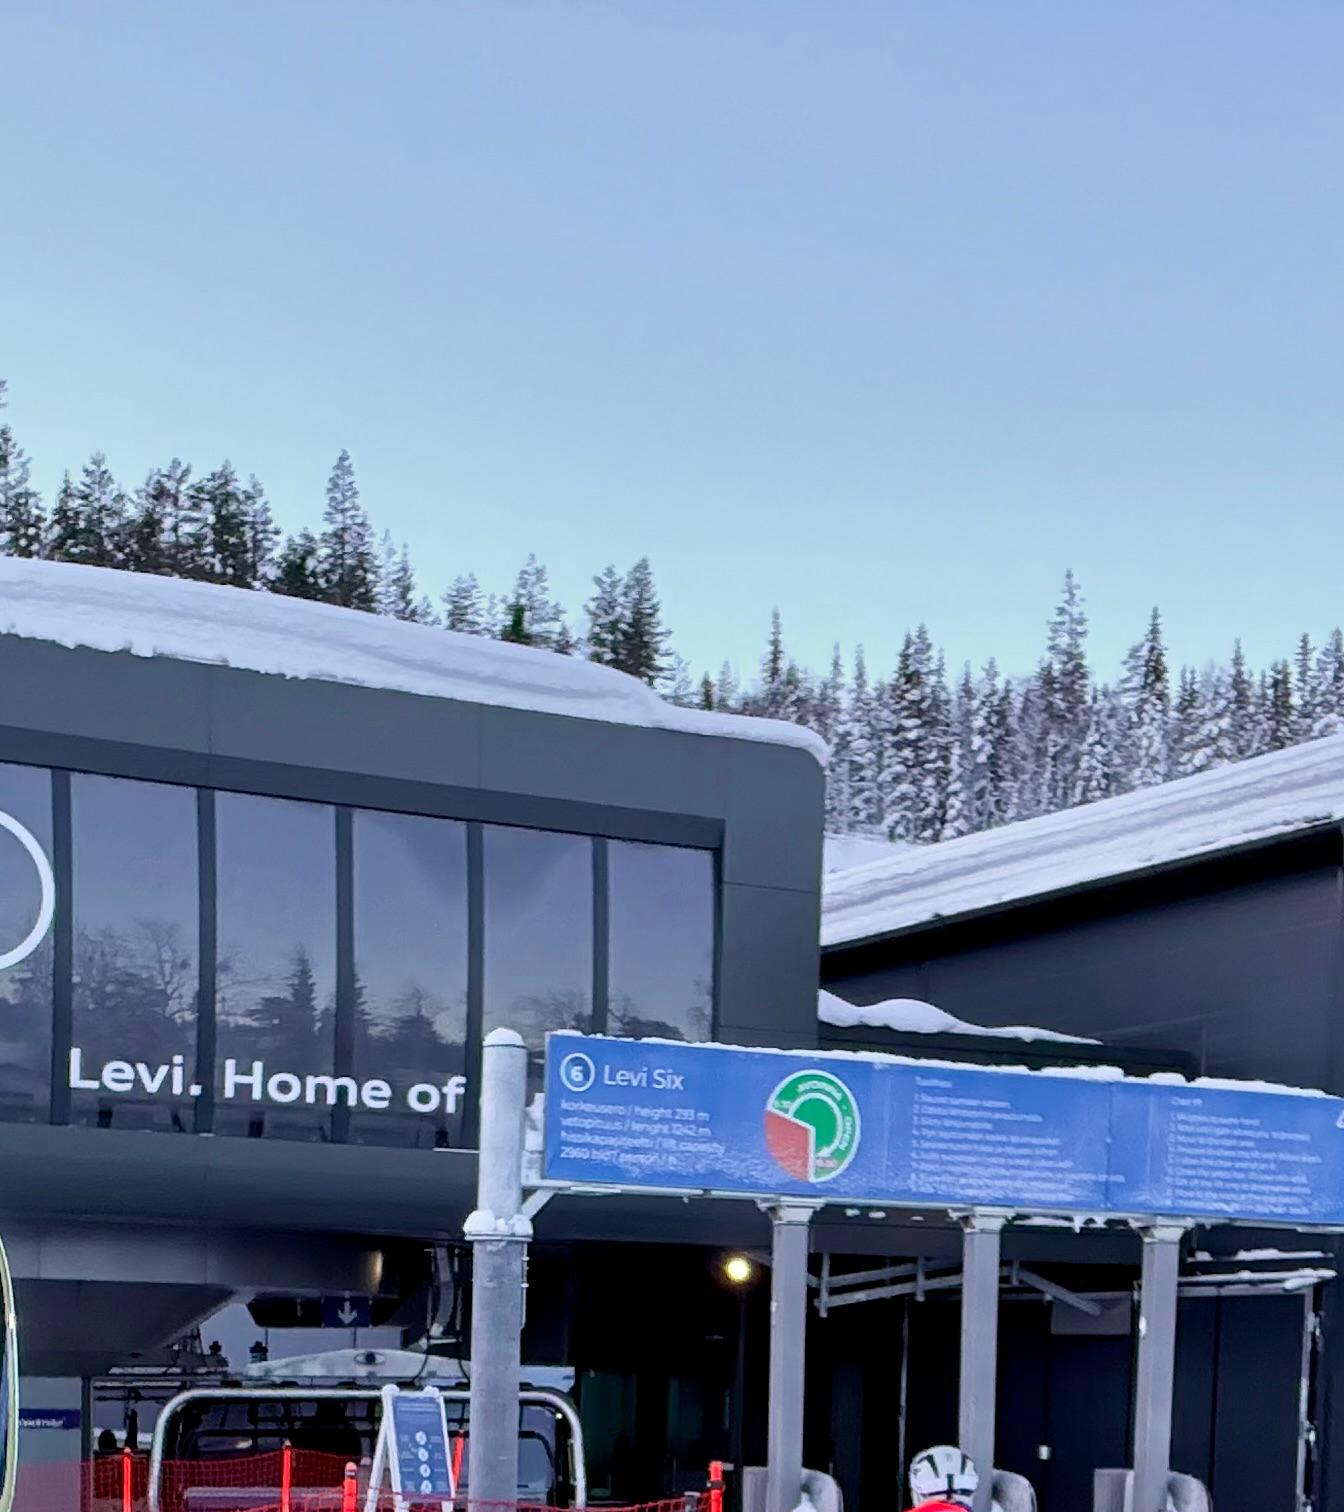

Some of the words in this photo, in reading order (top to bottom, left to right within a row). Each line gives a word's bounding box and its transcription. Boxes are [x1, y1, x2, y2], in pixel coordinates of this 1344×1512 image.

[69, 1047, 202, 1096] Levi.
[224, 1059, 392, 1108] Home
[407, 1075, 467, 1114] of
[570, 1066, 584, 1082] 6
[603, 1064, 648, 1088] Levi
[652, 1068, 685, 1091] Six
